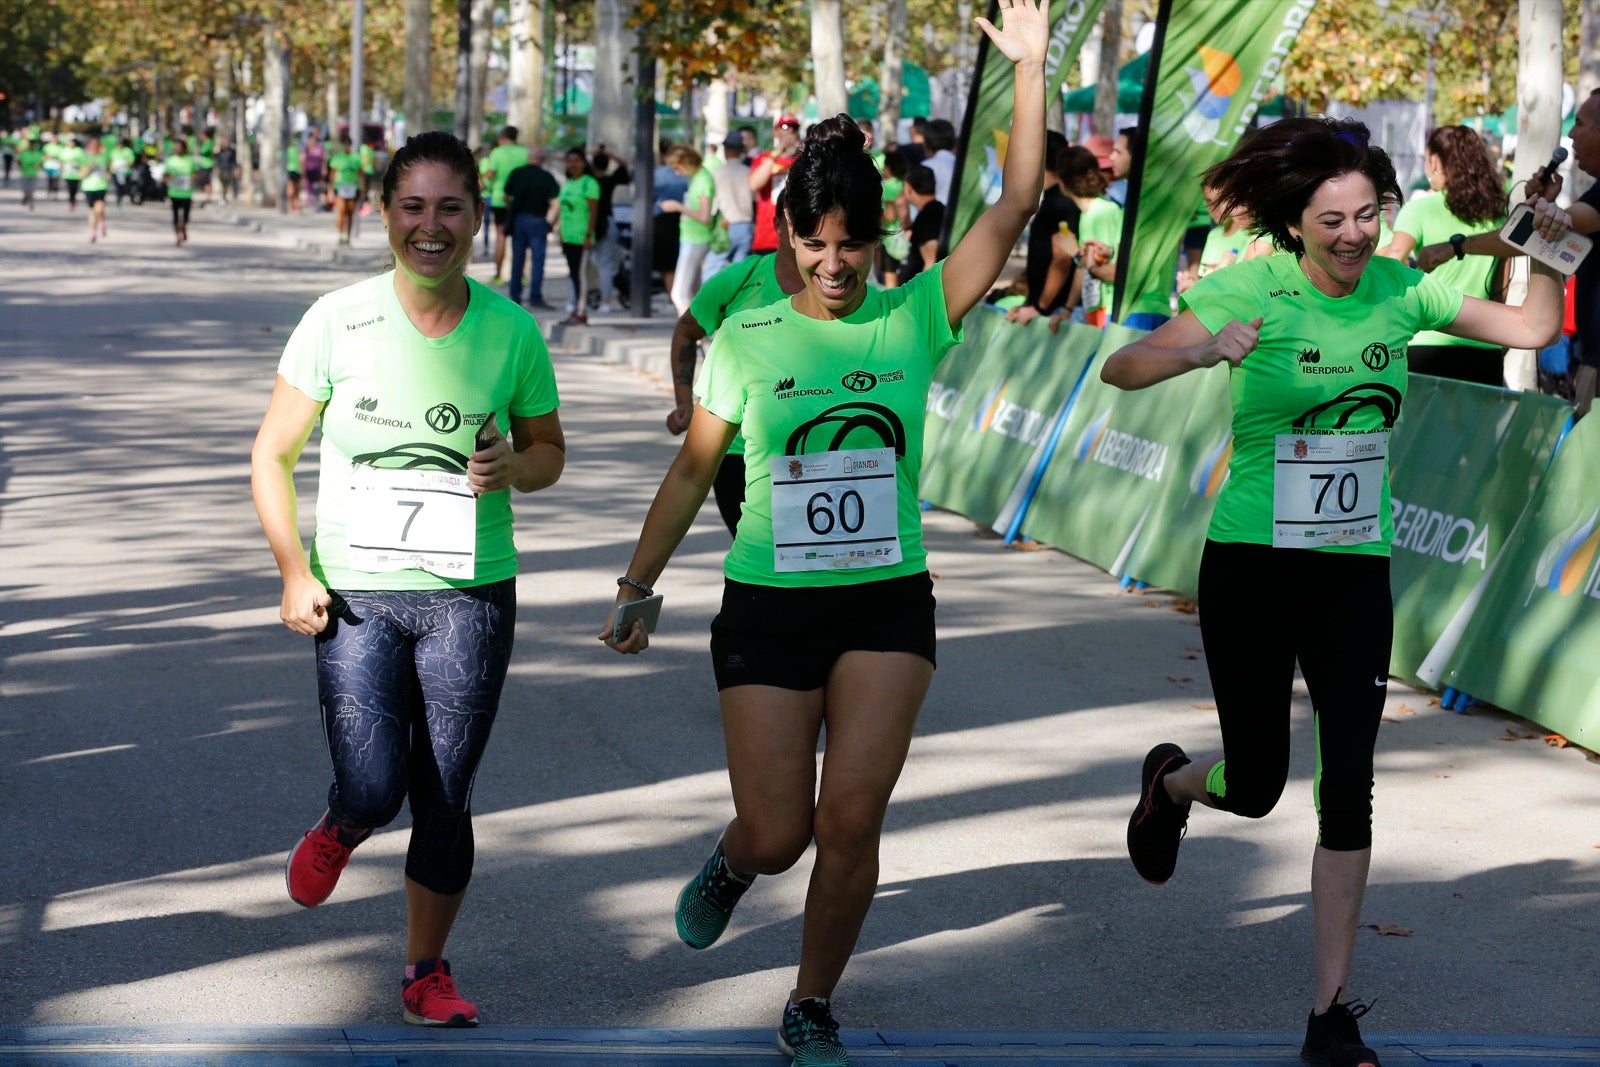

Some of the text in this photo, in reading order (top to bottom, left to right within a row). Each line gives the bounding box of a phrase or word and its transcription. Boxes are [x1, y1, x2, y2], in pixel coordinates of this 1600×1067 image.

[1045, 0, 1085, 88] DRO
[1234, 0, 1316, 135] IBERDR
[742, 320, 772, 329] luanvi
[1302, 365, 1354, 375] IBERDROLA
[879, 375, 905, 384] MUJER
[777, 388, 834, 400] IBERDROLA
[355, 412, 412, 430] IBERDROLA
[463, 418, 485, 426] MUJE
[1305, 428, 1335, 436] FORMA
[1093, 427, 1169, 482] IBERDROLA
[1310, 472, 1359, 514] 70
[397, 500, 425, 542] 7
[806, 489, 865, 535] 60
